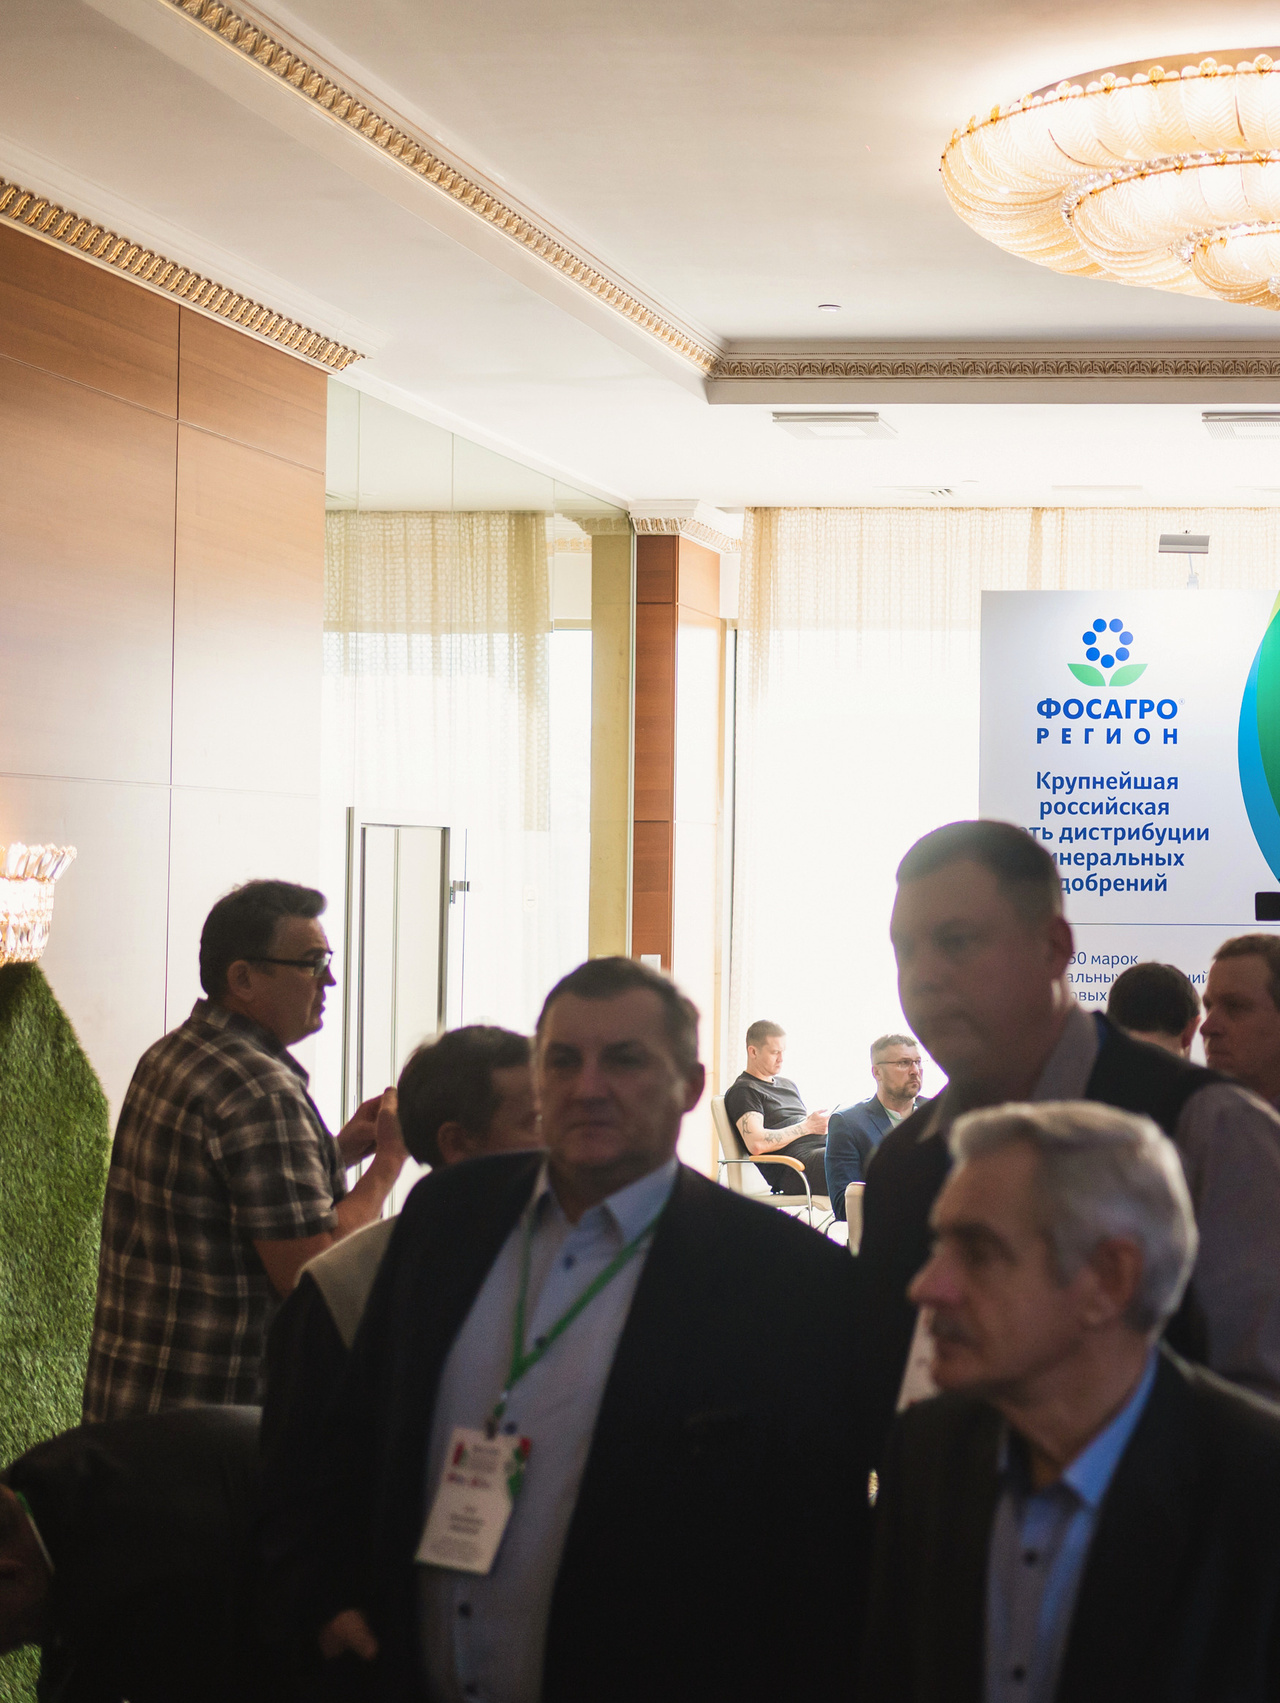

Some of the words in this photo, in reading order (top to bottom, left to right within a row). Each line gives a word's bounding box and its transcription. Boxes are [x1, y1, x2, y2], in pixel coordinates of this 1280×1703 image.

[1036, 698, 1178, 719] ФОСАГРО
[1036, 728, 1178, 744] РЕГИОН
[1036, 771, 1179, 794] Крупнейшая
[1040, 797, 1170, 820] российская
[1059, 822, 1209, 846] дистрибуции
[1060, 873, 1167, 896] добрений
[1091, 955, 1138, 969] марок
